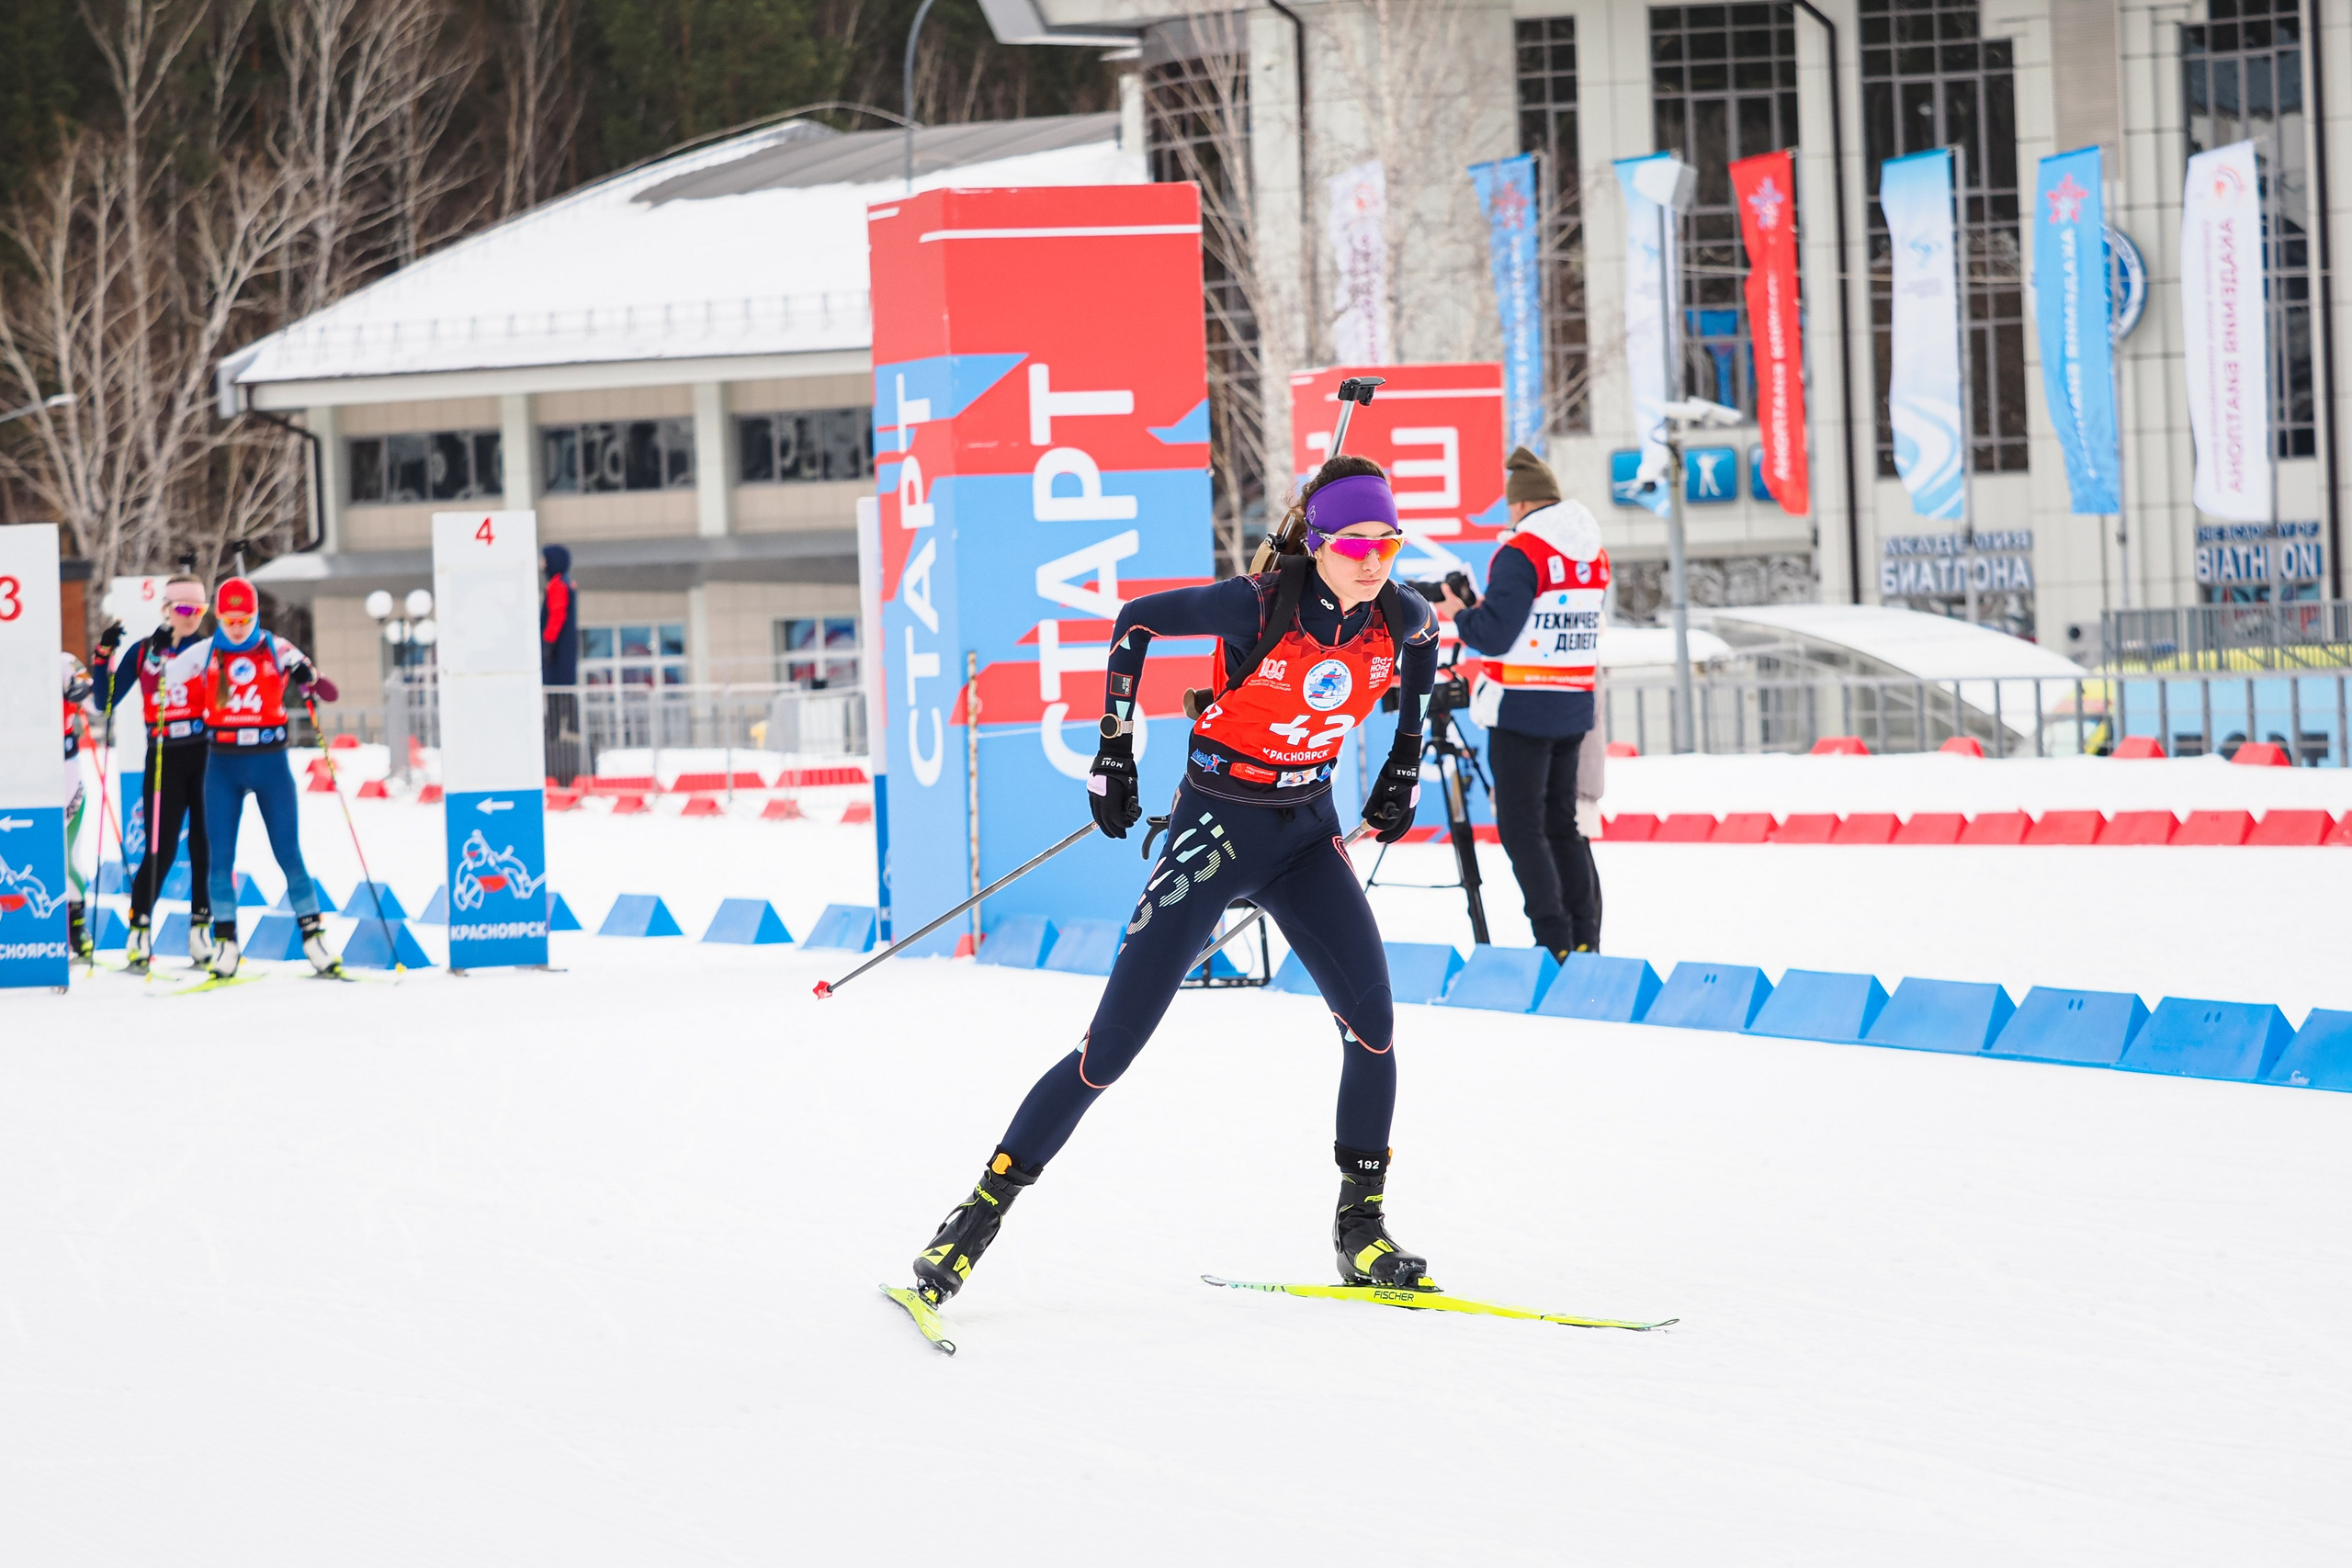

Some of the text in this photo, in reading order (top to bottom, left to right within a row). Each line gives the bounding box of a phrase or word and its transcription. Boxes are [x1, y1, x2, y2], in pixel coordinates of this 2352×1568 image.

[475, 517, 496, 545] 4
[1028, 363, 1148, 782] СТАРТ
[1880, 556, 2033, 594] БИАТЛОНА
[2196, 543, 2316, 583] BIATHON
[141, 580, 155, 601] 5
[897, 373, 944, 787] СТАРТ
[0, 575, 23, 622] 3
[225, 683, 264, 714] 44
[1269, 714, 1356, 749] 42
[451, 919, 547, 941] КРАСНОЯРСК
[1357, 1159, 1380, 1169] 192
[1374, 1291, 1415, 1302] FISCHER
